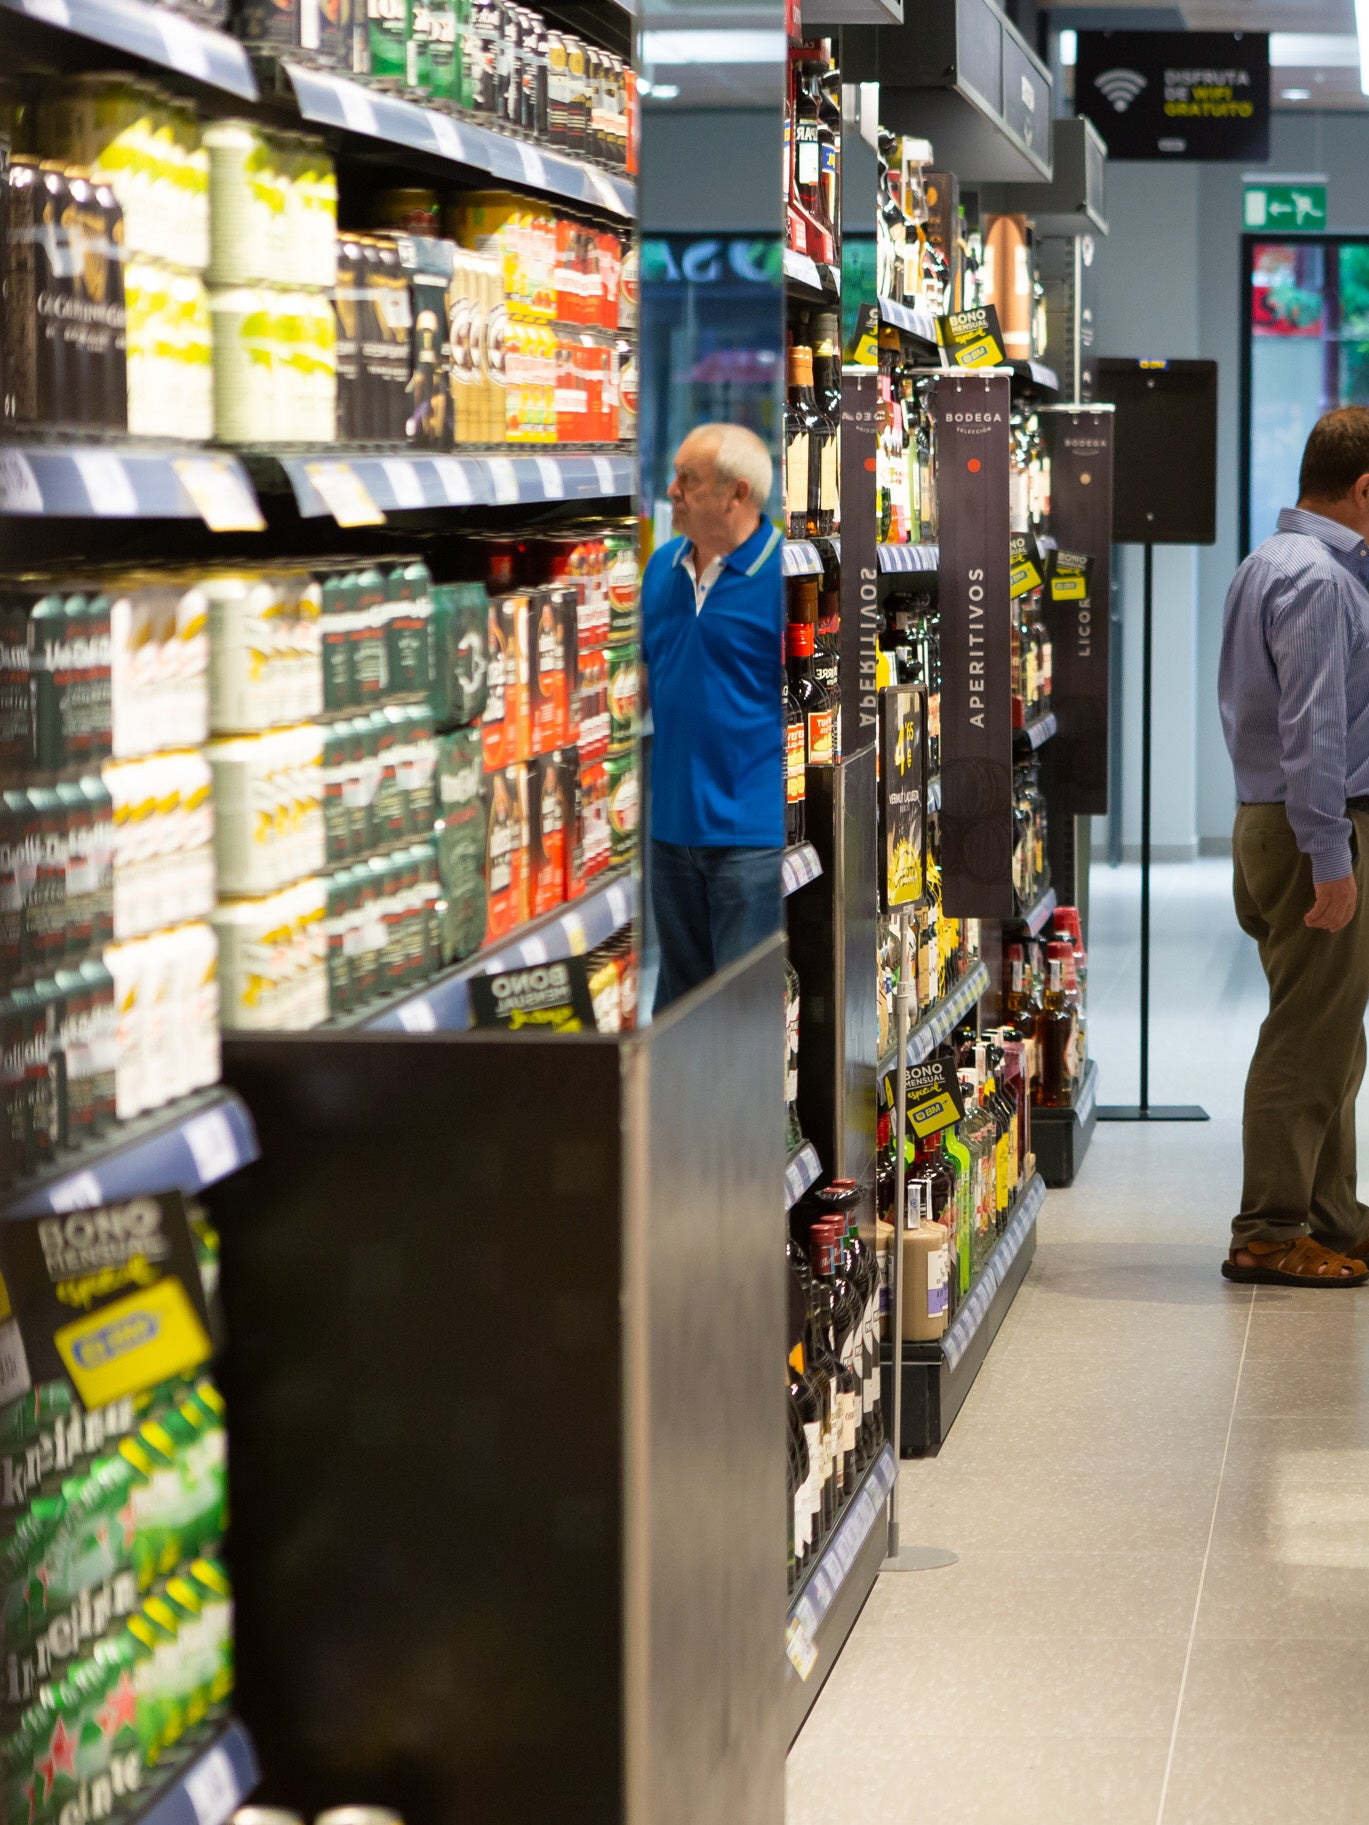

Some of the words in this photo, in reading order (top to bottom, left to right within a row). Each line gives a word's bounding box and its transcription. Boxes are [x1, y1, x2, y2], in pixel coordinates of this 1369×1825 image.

[949, 309, 987, 327] BONO
[945, 413, 1002, 423] BODEGA
[956, 427, 992, 435] SELECCIÓN
[1064, 438, 1107, 448] BODEGA
[968, 568, 985, 729] APERITIVOS
[904, 1063, 943, 1080] BONO
